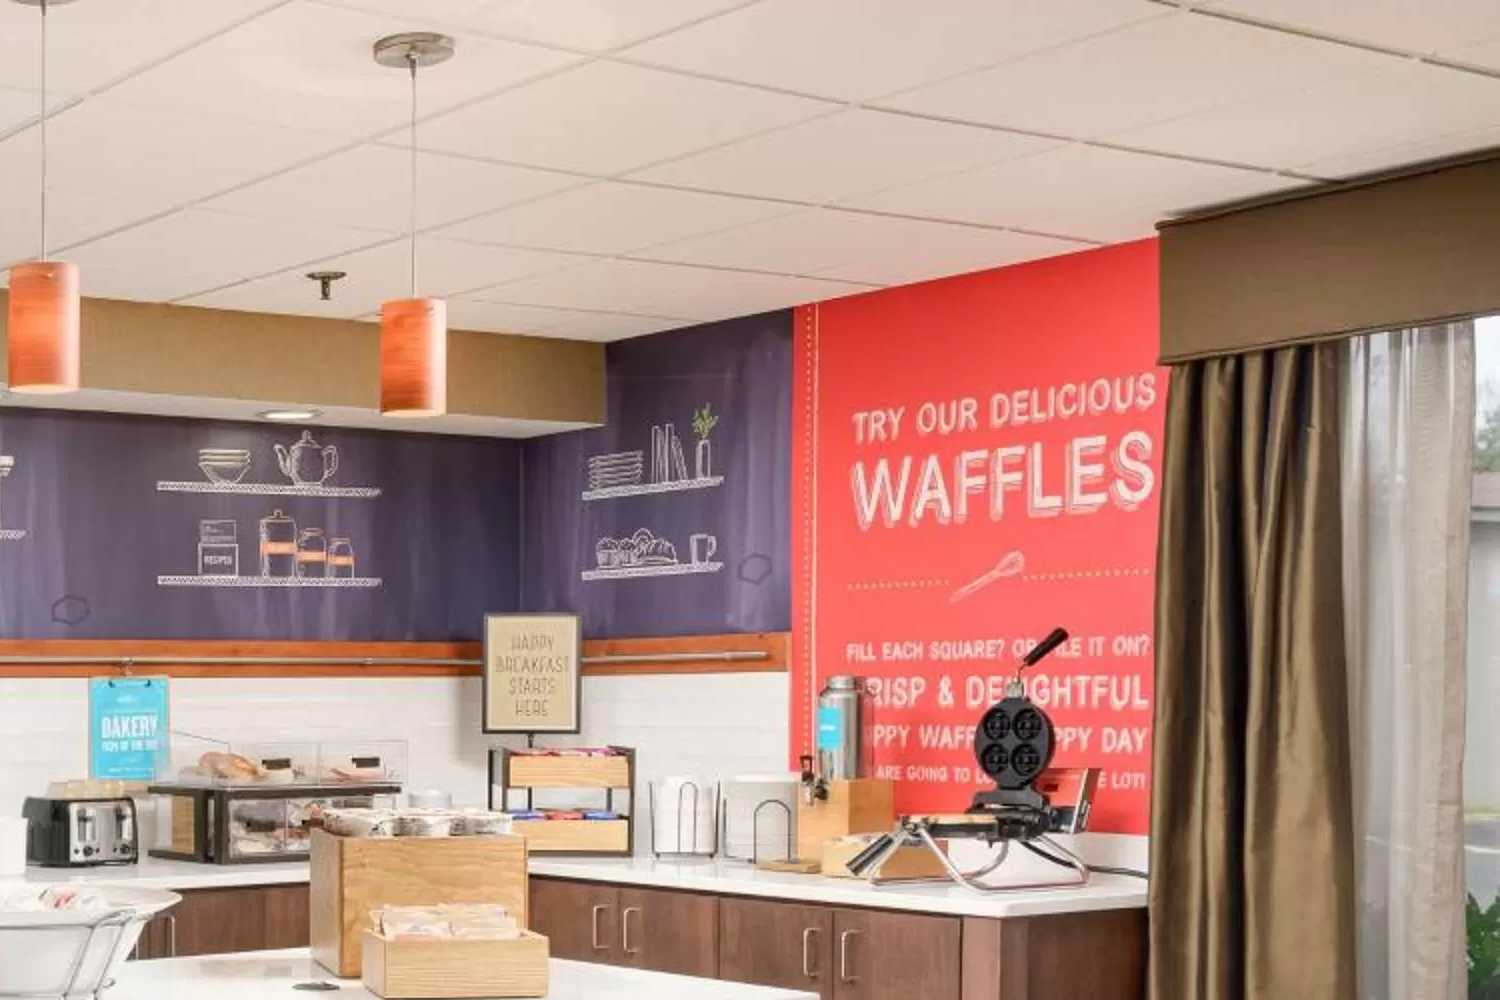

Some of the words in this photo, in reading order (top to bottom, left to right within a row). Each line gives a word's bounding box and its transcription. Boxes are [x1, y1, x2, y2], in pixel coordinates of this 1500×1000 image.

[853, 406, 904, 444] TRY
[916, 397, 977, 436] OUR
[990, 372, 1156, 428] DELICIOUS
[851, 431, 1154, 531] WAFFLES
[511, 634, 554, 650] HAPPY
[845, 641, 876, 663] FILL
[882, 640, 924, 661] EACH
[930, 638, 1005, 661] SQUARE?
[1088, 635, 1106, 657] IT
[1112, 633, 1150, 657] ON?
[496, 655, 569, 673] BREAKFAST
[508, 676, 556, 695] STARTS
[866, 675, 926, 708] RISP
[938, 674, 954, 707] &
[515, 699, 548, 717] HERE
[101, 715, 157, 739] BAKERY
[873, 723, 911, 749] PPY
[1101, 726, 1149, 754] DAY
[876, 765, 901, 781] ARE
[907, 765, 948, 782] GOING
[954, 767, 970, 784] TO
